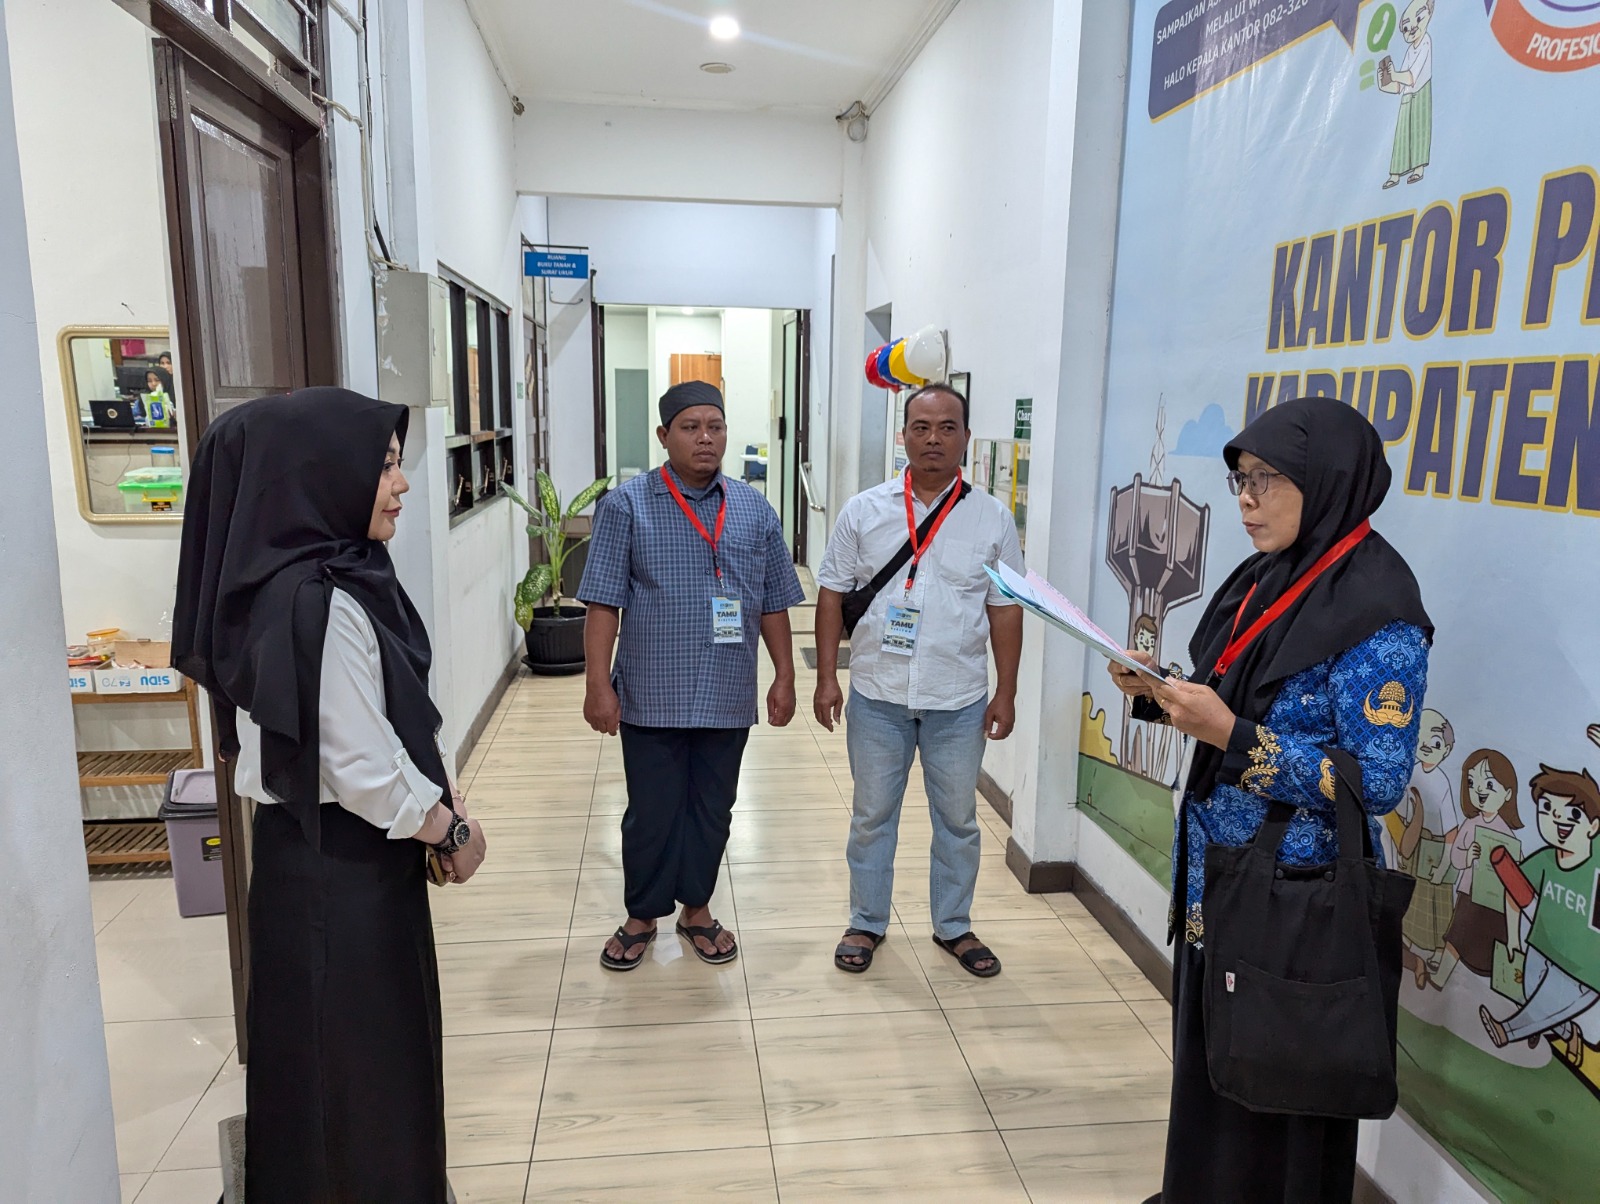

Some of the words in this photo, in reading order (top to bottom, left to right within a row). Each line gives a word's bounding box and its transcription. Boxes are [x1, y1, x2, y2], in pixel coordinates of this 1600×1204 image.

[1157, 0, 1206, 45] SAMPAIKAN
[1205, 1, 1247, 38] MELALUI
[1164, 66, 1185, 90] HALO
[1186, 47, 1219, 76] KEPALA
[1221, 19, 1261, 56] KANTOR
[1266, 186, 1512, 353] KANTOR
[1521, 164, 1600, 330] P
[890, 619, 914, 629] TAMU
